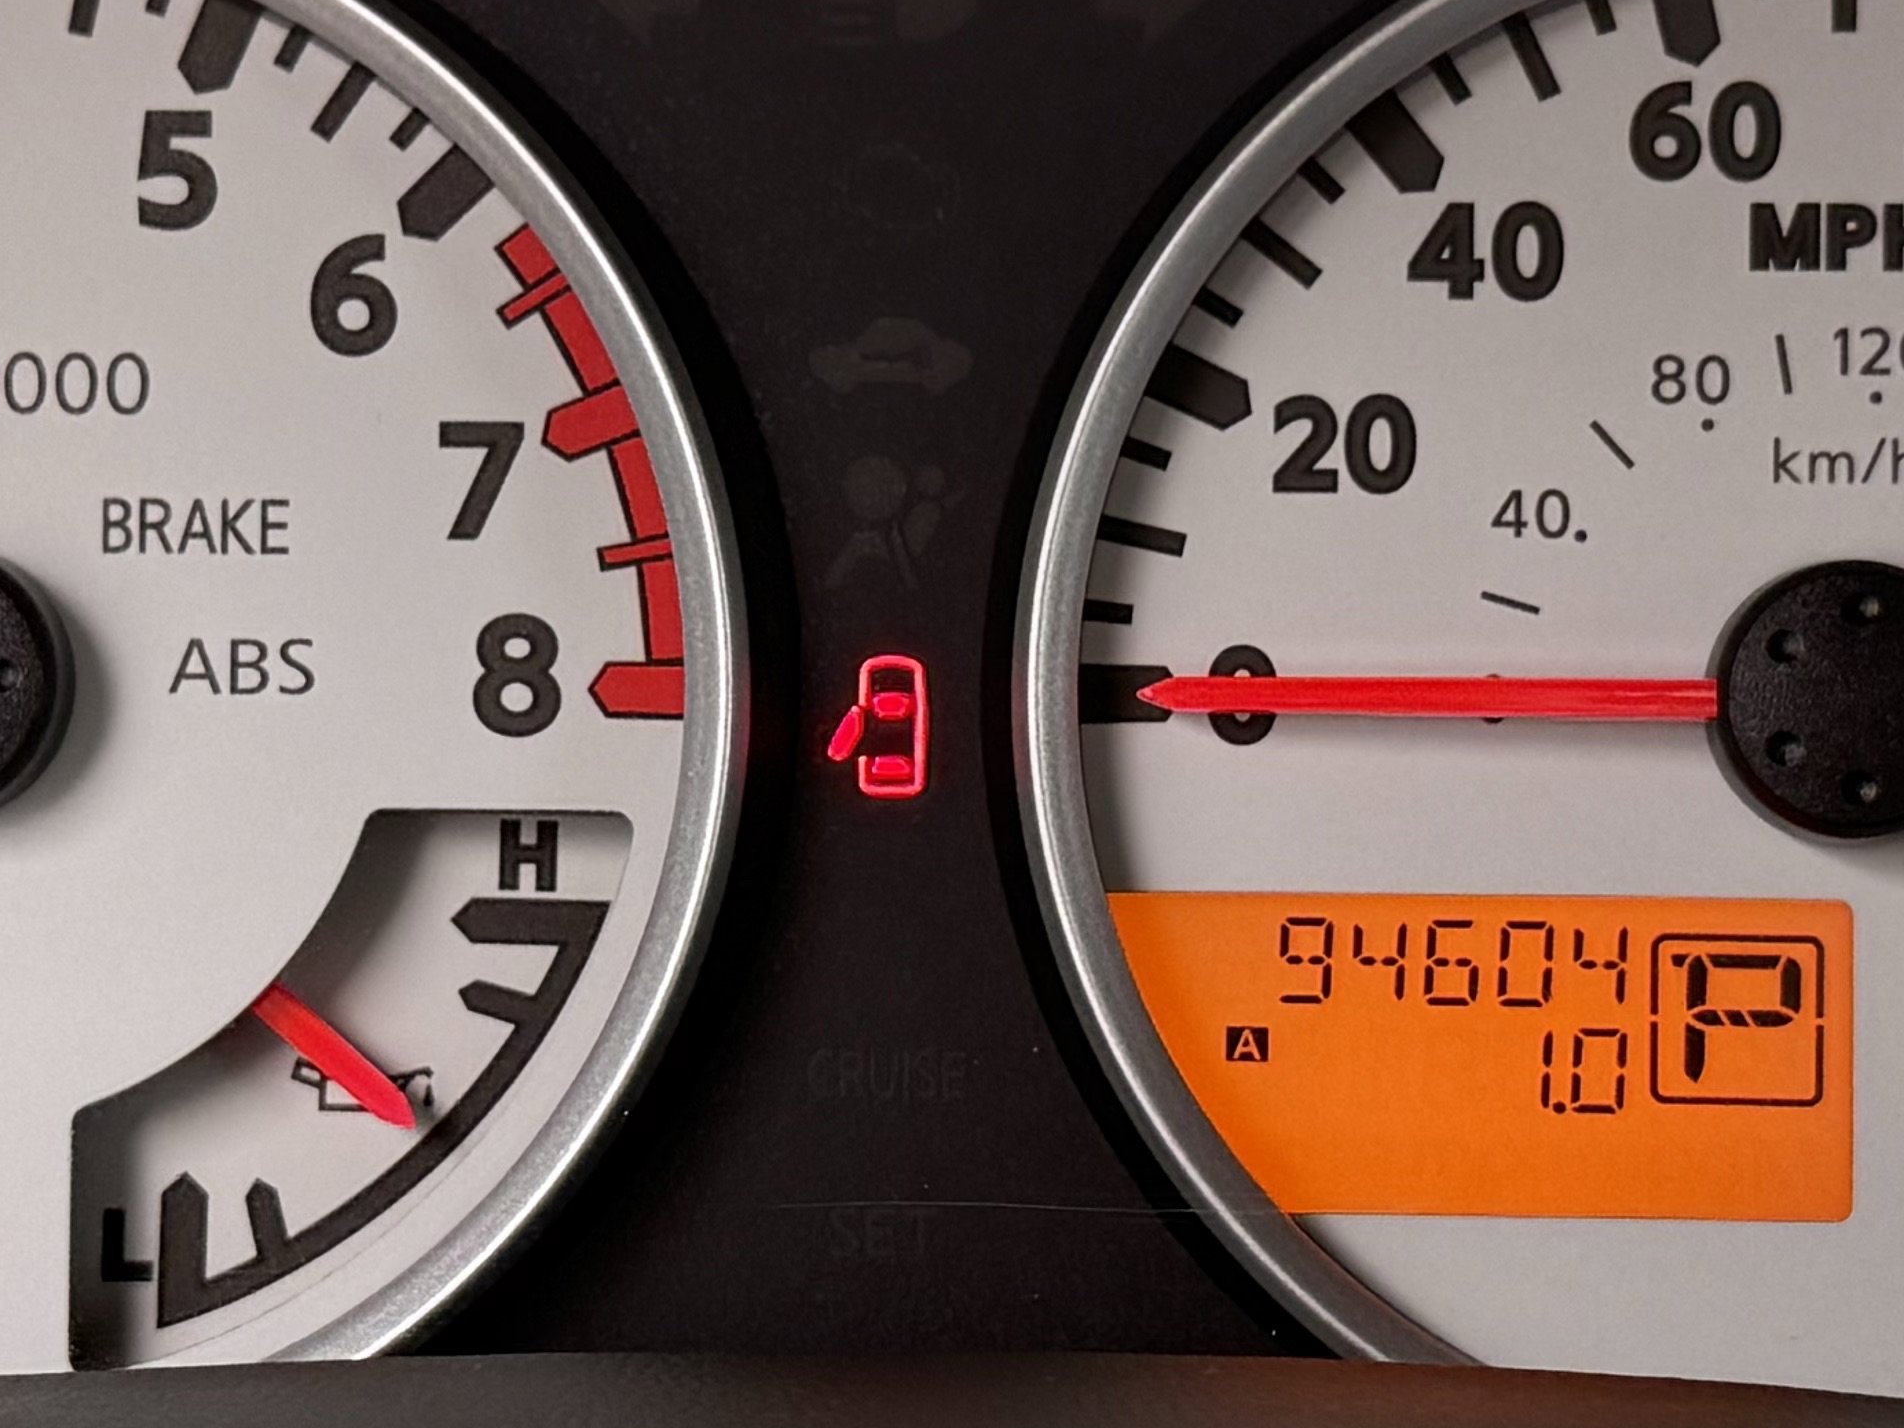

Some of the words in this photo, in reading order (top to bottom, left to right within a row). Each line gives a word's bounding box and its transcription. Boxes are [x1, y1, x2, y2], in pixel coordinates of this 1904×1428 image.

[136, 109, 217, 231] 5
[1629, 81, 1781, 181] 60
[310, 233, 399, 357] 6
[1407, 201, 1564, 301] 40
[1652, 354, 1731, 405] 80
[438, 421, 525, 541] 7
[1272, 393, 1417, 494] 20
[101, 498, 291, 556] BRAKE
[1491, 489, 1571, 538] 40
[169, 637, 316, 697] ABS
[472, 613, 562, 737] 8
[1208, 645, 1278, 746] 0
[499, 820, 558, 891] H
[1279, 917, 1628, 1008] 94604
[1230, 1028, 1264, 1060] A
[1671, 954, 1803, 1082] P
[807, 1048, 967, 1100] CRUISE
[1541, 1028, 1628, 1115] 1.0
[101, 1209, 153, 1282] L
